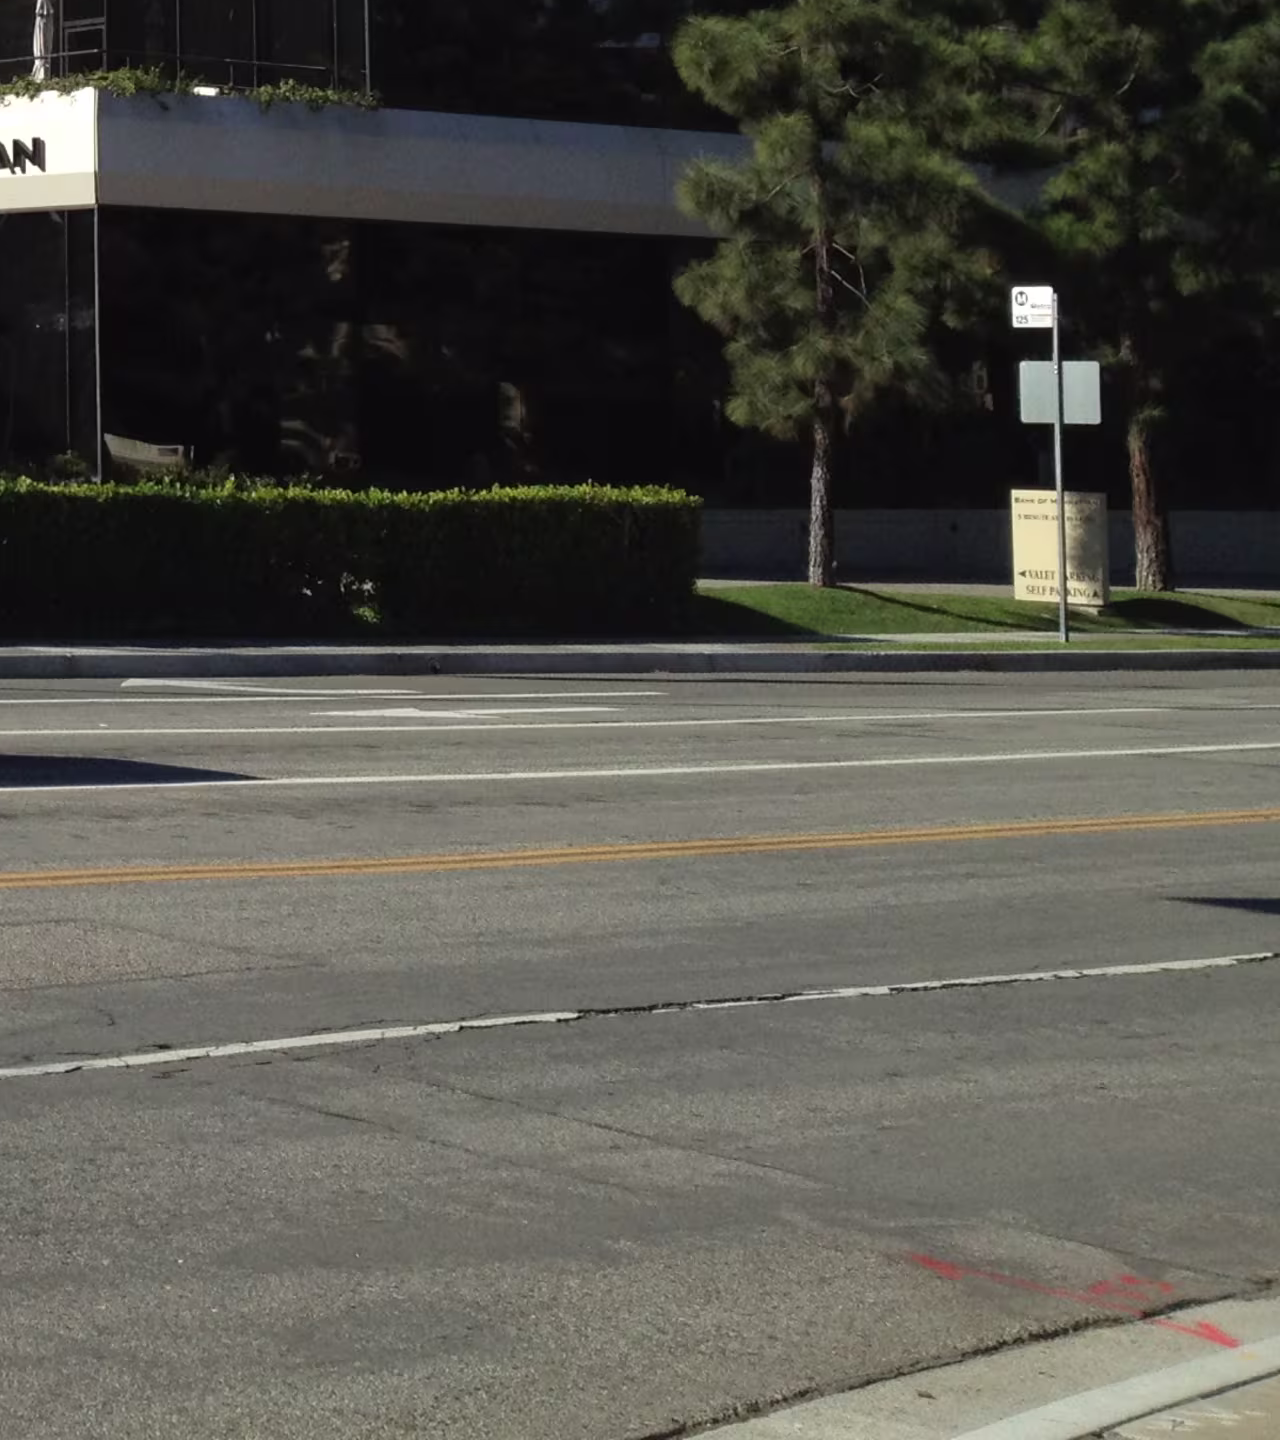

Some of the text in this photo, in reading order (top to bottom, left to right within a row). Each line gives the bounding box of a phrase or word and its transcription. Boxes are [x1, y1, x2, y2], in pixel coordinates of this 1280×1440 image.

[1015, 314, 1029, 325] 125
[1028, 568, 1056, 581] VALET
[1025, 584, 1047, 596] SELF
